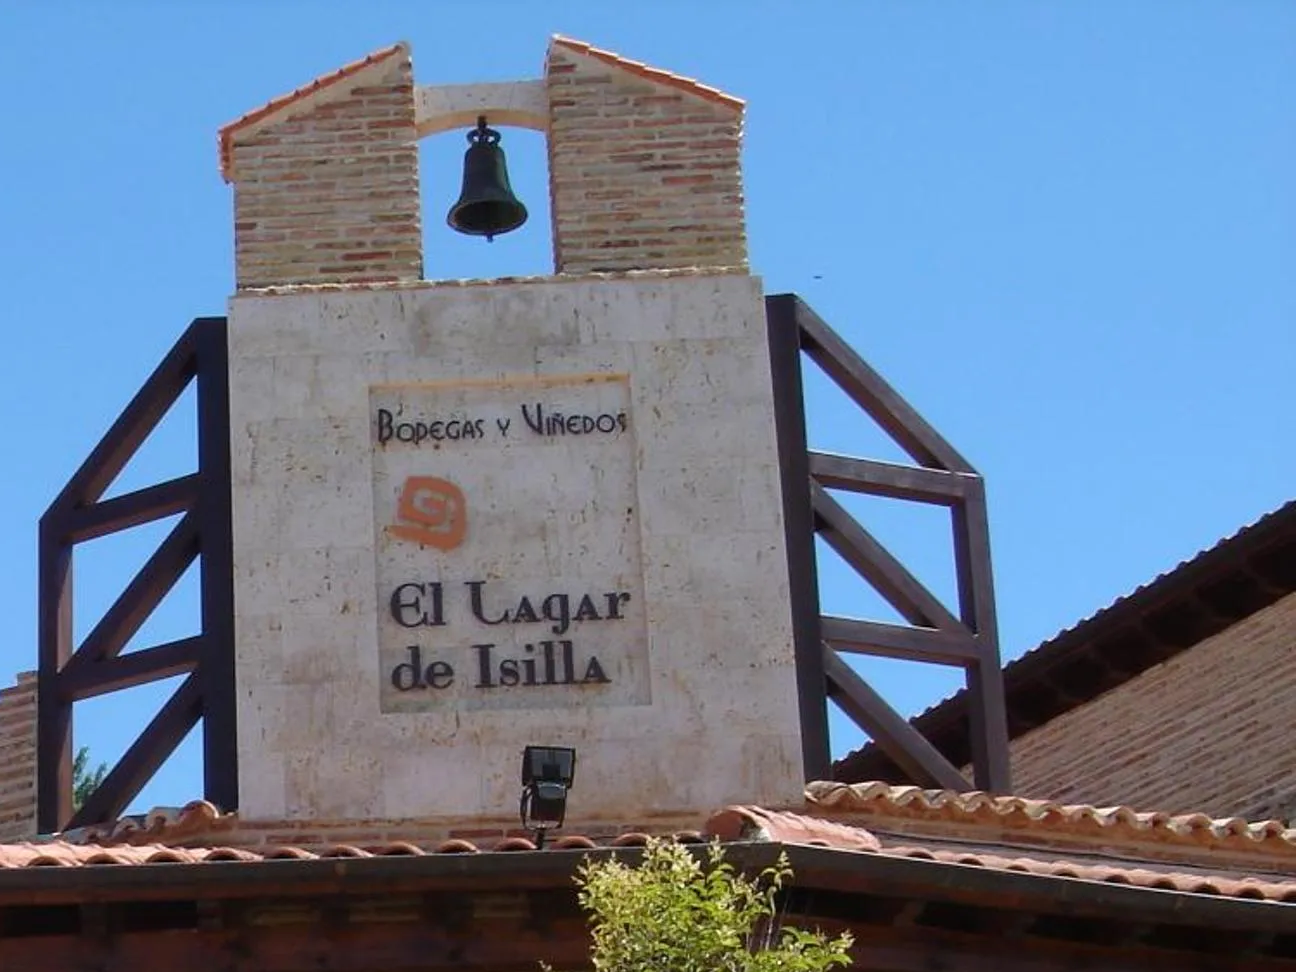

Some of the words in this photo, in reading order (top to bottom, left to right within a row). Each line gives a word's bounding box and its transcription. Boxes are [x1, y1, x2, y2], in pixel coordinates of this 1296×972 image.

[378, 408, 484, 444] BODEGAS
[390, 581, 446, 628] El
[391, 645, 454, 692] de
